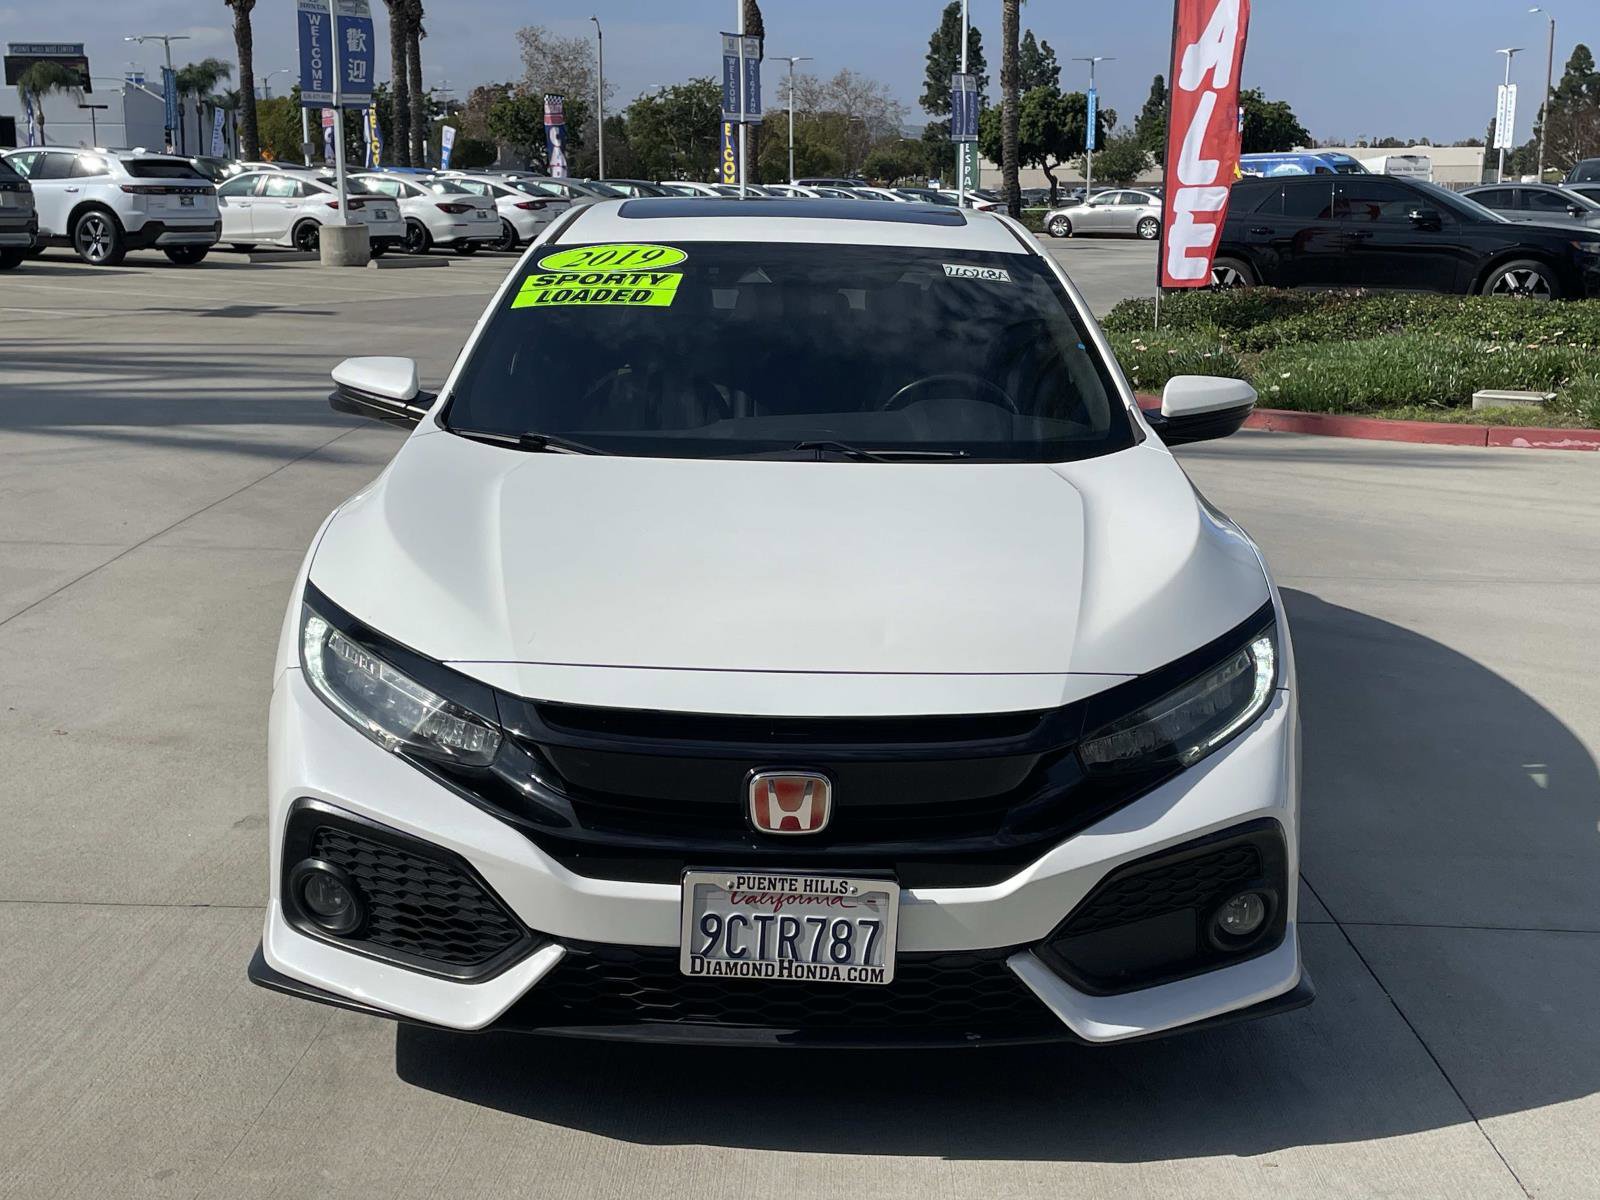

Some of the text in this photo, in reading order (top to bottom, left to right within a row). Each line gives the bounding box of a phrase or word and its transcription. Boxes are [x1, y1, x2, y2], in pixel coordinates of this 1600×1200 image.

[305, 13, 322, 90] WELCOME
[345, 27, 367, 83] 歡迎
[726, 57, 736, 112] WELCOME
[1167, 0, 1240, 280] ALE
[560, 249, 665, 268] 2019
[532, 272, 673, 287] SPORTY
[534, 288, 654, 304] LOADED
[730, 891, 857, 912] California
[736, 876, 849, 895] PUENTE HILLS
[700, 913, 880, 966] 9CTR787
